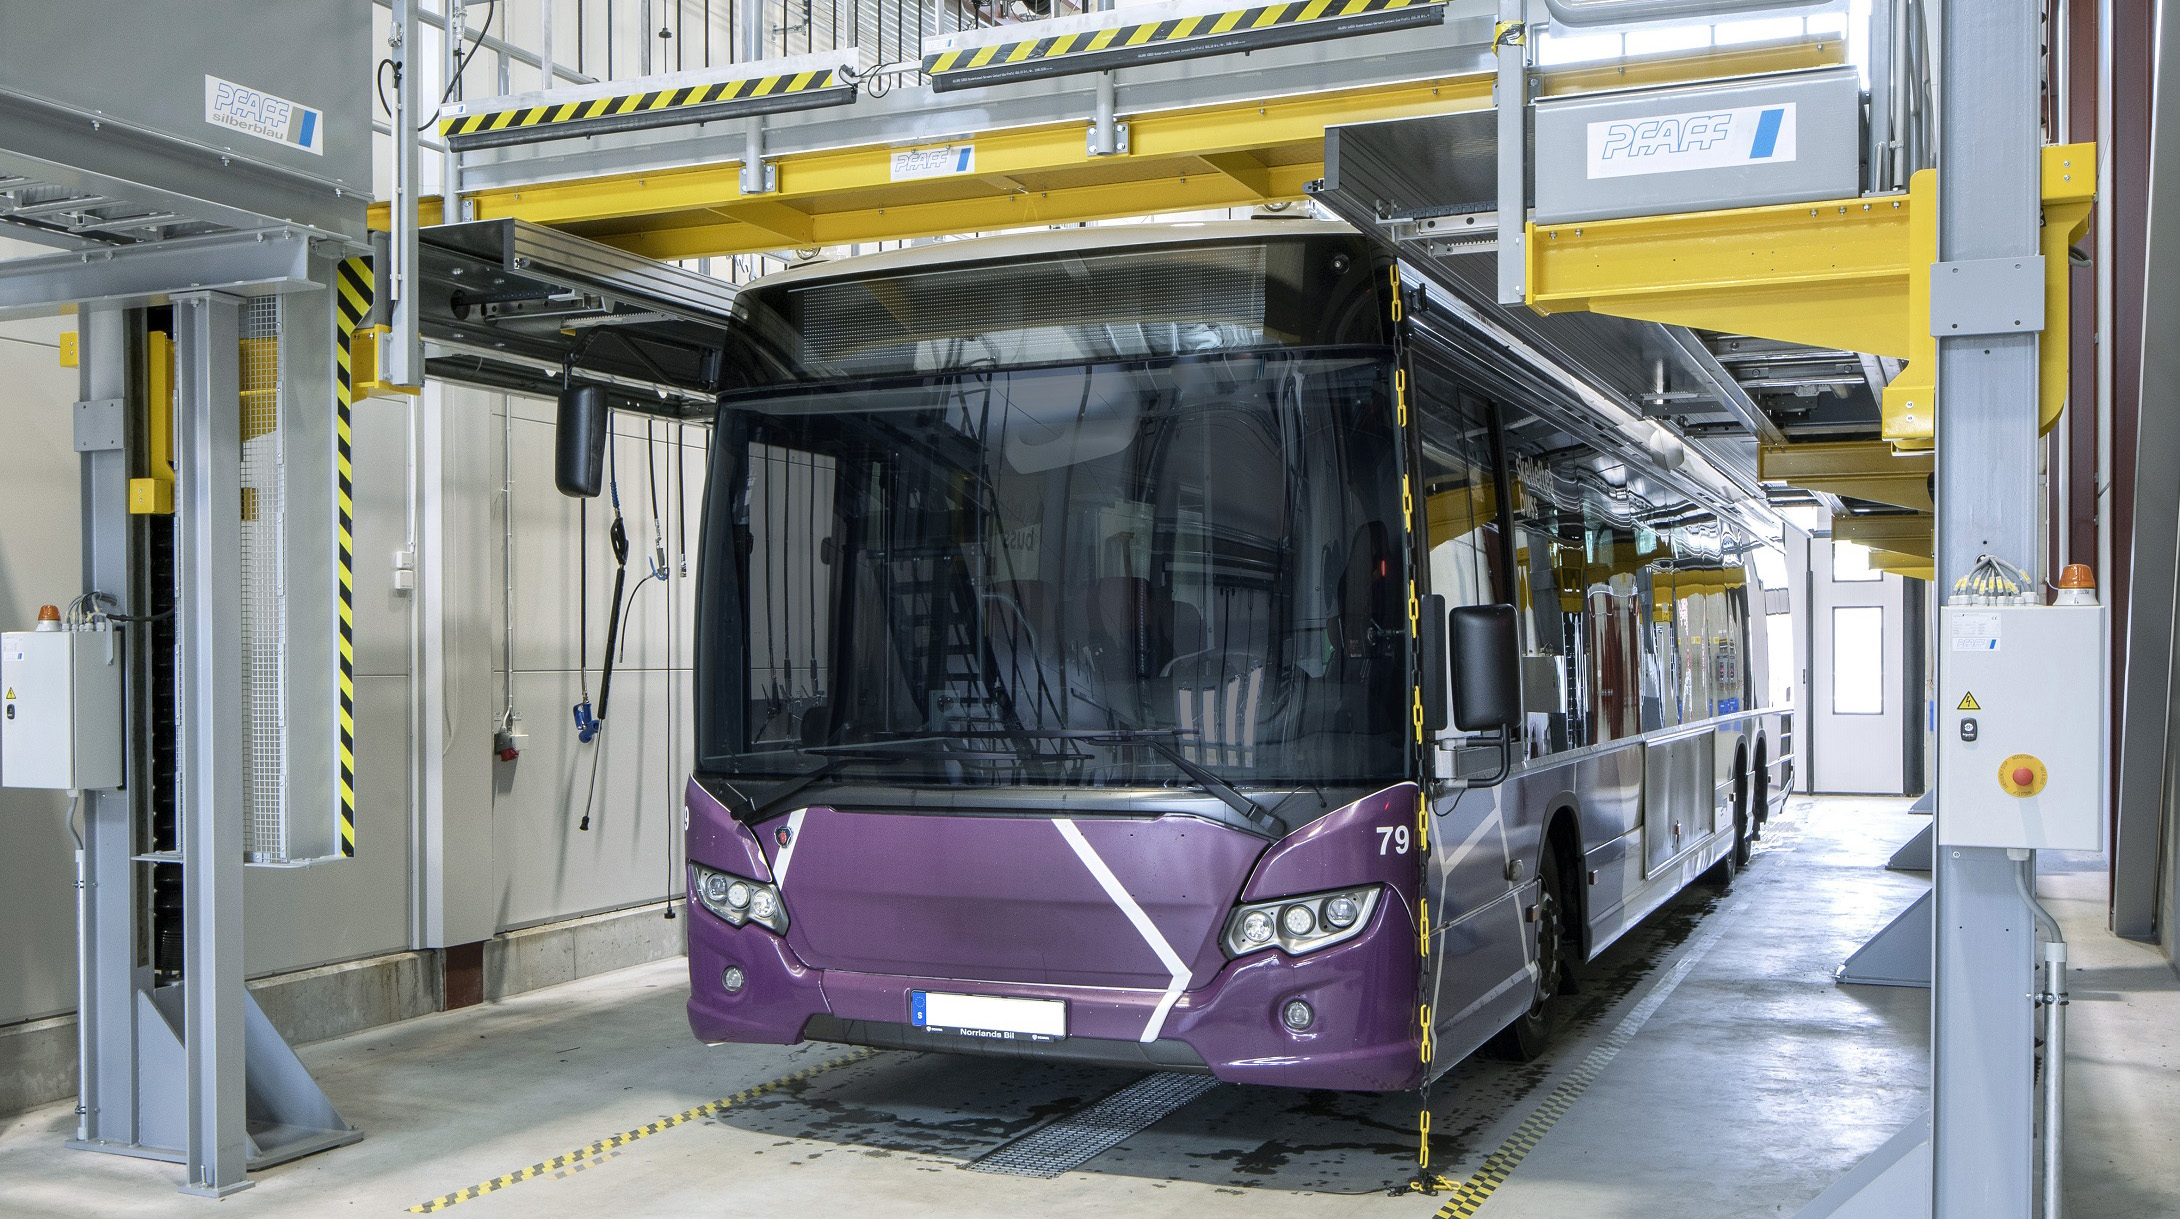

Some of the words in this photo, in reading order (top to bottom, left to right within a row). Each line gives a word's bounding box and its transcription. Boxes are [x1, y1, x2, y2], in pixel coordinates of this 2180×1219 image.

[214, 82, 289, 128] PFAFF
[212, 113, 284, 140] silberblau
[1602, 113, 1732, 160] PFAFF
[894, 150, 949, 172] PFAFF
[1518, 484, 1539, 520] buss
[1376, 824, 1410, 855] 79
[917, 1011, 923, 1019] S
[960, 1028, 1002, 1039] Norrlands
[1004, 1031, 1015, 1040] Bil
